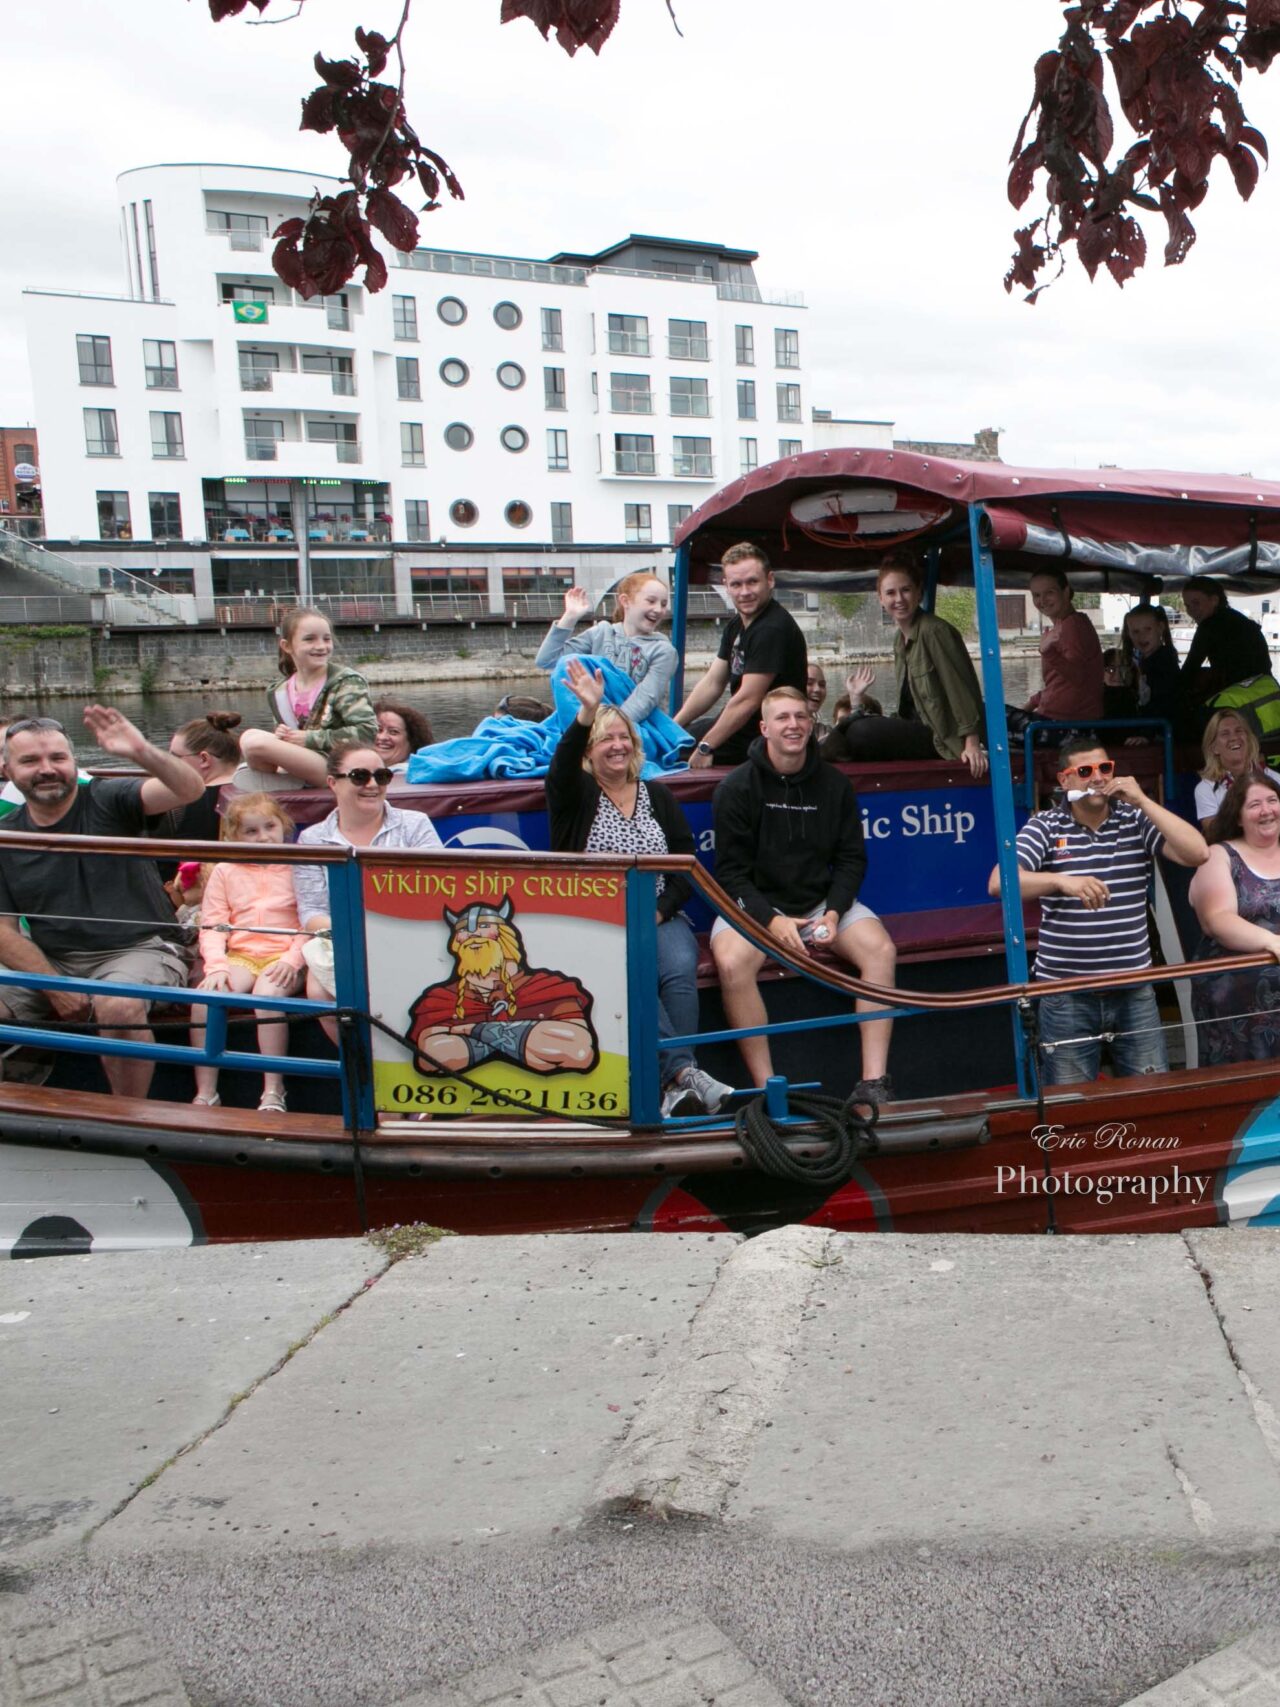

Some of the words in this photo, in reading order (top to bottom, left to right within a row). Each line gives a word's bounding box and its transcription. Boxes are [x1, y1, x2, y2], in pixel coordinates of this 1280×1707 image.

[901, 803, 975, 844] Ship
[392, 1083, 458, 1106] 086
[469, 1087, 619, 1112] 2621136
